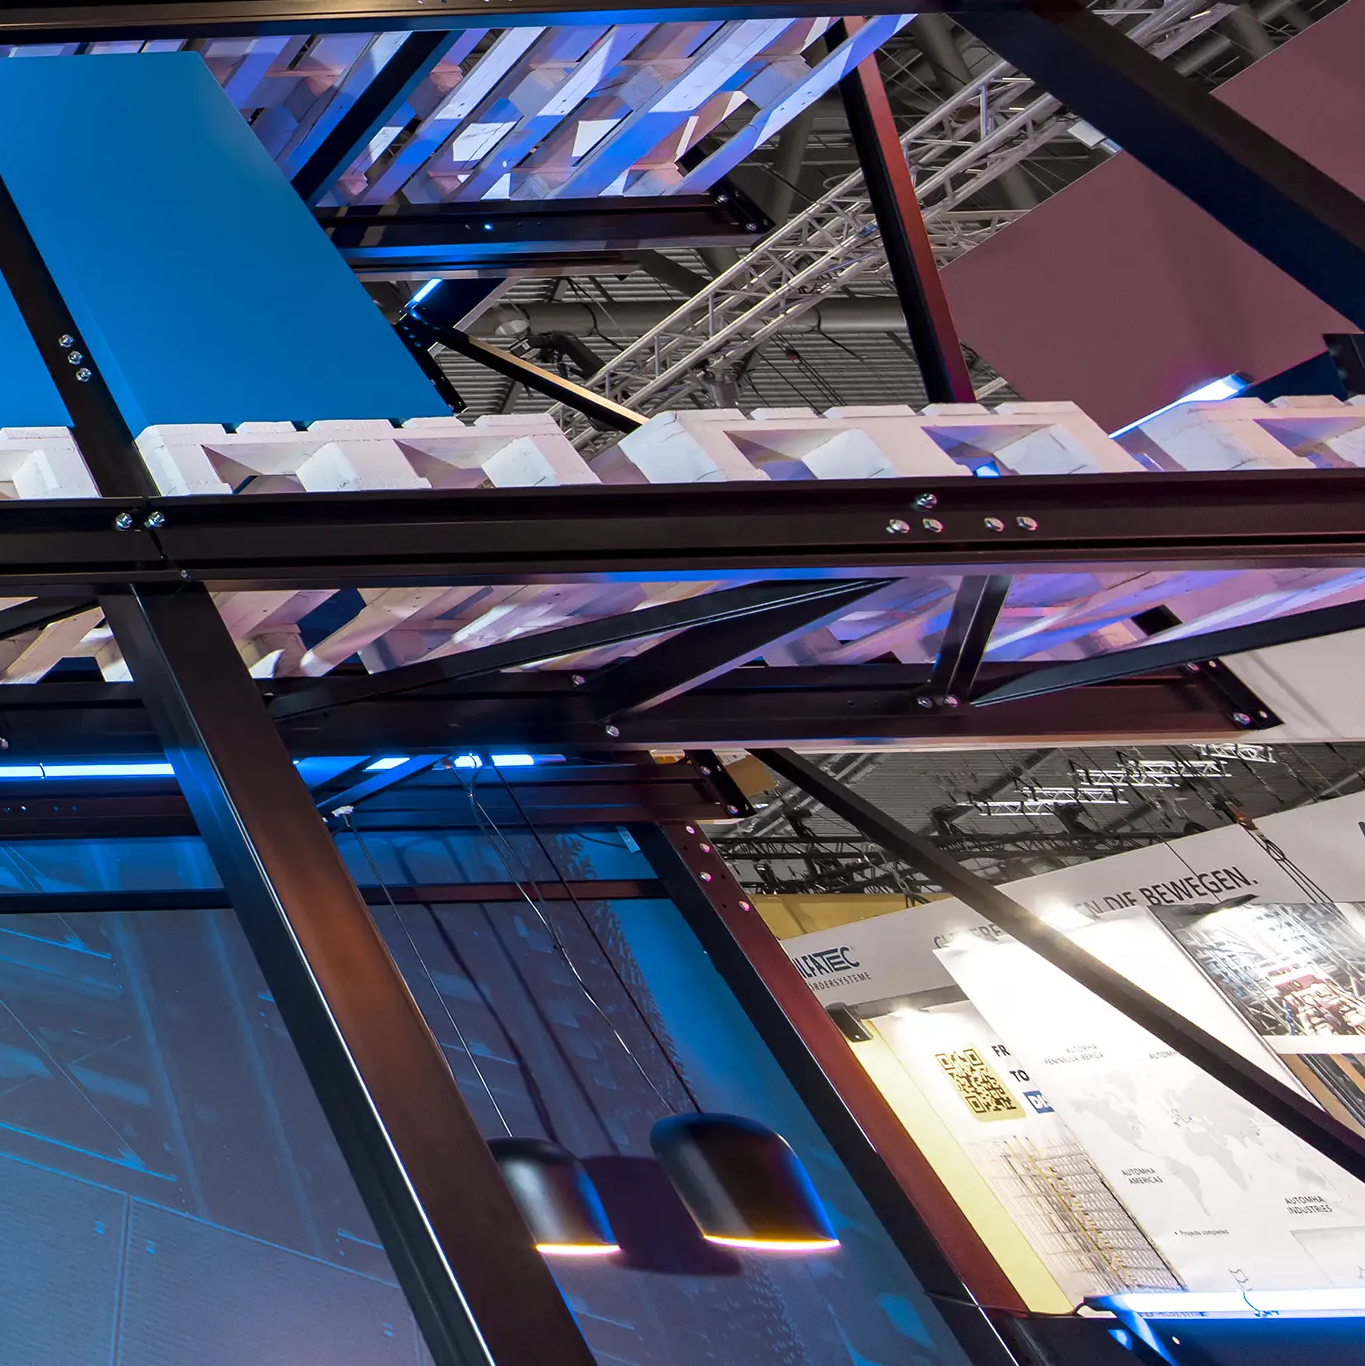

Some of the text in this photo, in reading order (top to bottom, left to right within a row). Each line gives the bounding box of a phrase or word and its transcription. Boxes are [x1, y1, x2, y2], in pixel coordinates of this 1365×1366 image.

[1103, 892, 1137, 911] DIE
[1138, 866, 1259, 906] BEWEGEN.
[1009, 1069, 1030, 1082] TO
[1284, 1195, 1326, 1205] AUTOMHA
[1286, 1204, 1333, 1214] INDUSTRIES
